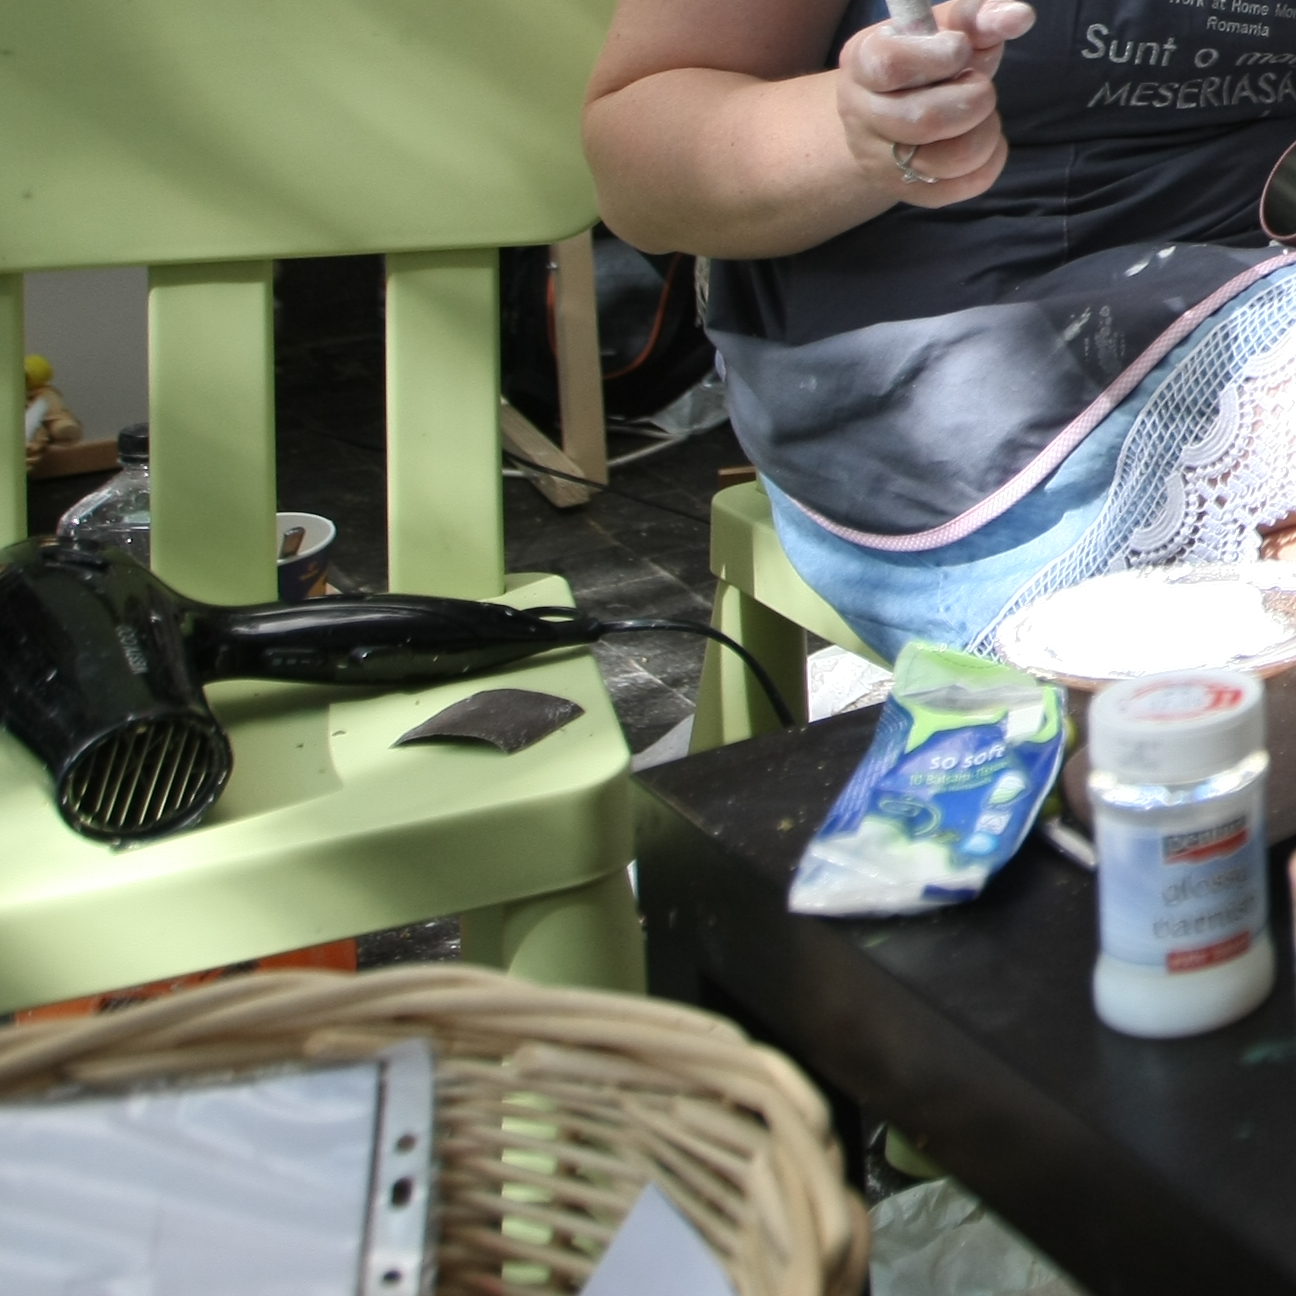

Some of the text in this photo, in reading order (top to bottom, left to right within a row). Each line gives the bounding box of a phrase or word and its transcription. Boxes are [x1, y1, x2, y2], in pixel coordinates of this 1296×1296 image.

[1206, 16, 1270, 37] Romania
[1081, 23, 1178, 66] Sunt
[1194, 48, 1220, 68] o
[929, 743, 1006, 770] so soft
